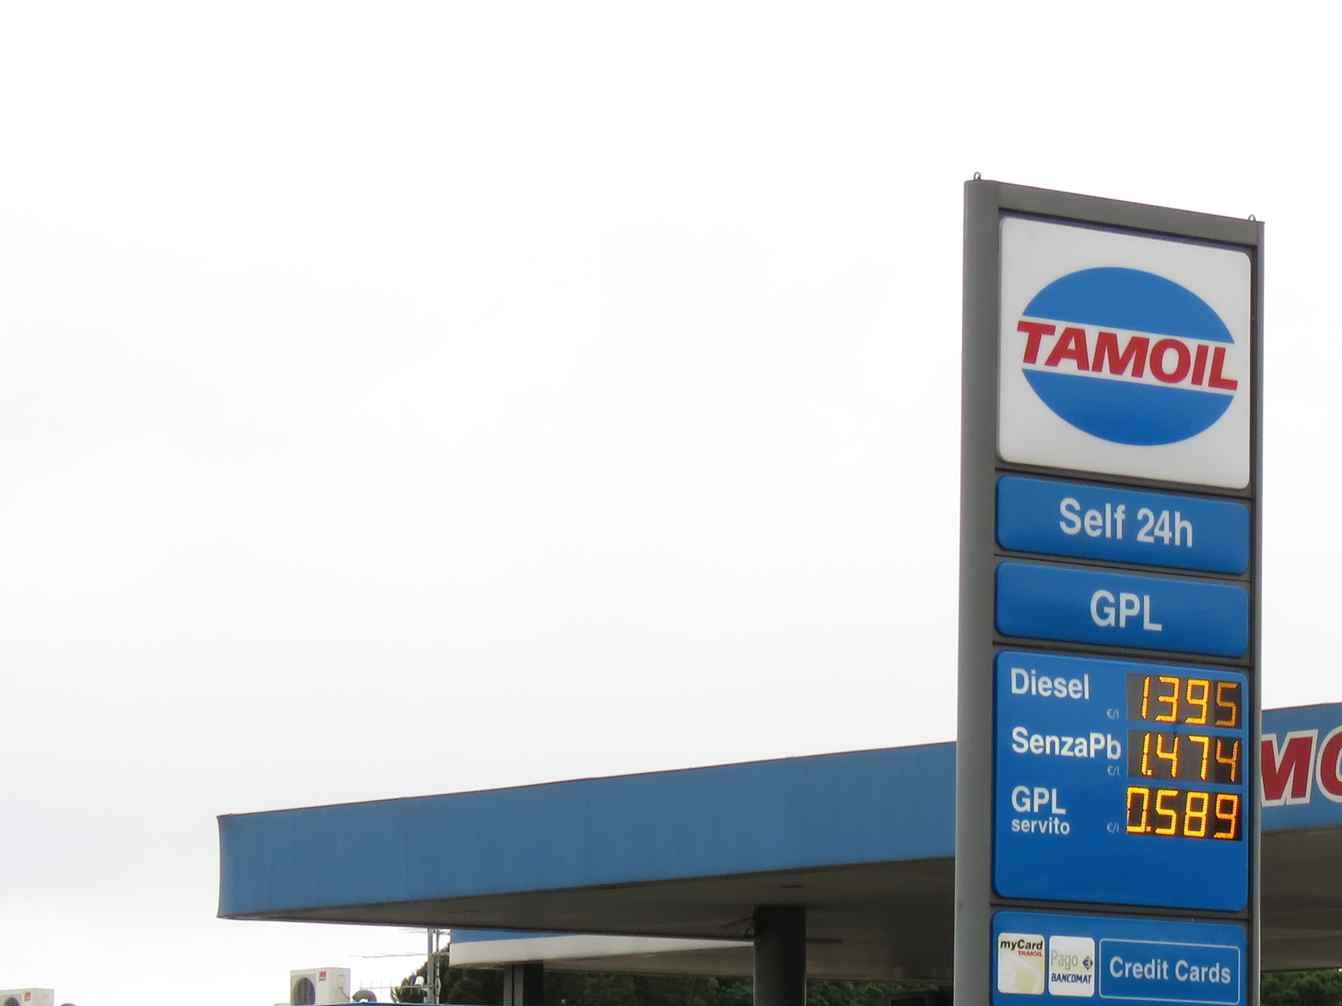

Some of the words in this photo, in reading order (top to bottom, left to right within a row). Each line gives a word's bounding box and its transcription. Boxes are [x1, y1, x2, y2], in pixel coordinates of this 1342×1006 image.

[1017, 320, 1238, 391] TAMOIL
[1059, 498, 1126, 539] Self
[1136, 507, 1192, 547] 24h
[1090, 589, 1162, 632] GPL
[1010, 667, 1090, 700] Diesel
[1011, 726, 1121, 760] SenzaPb
[1011, 785, 1067, 815] GPL
[1011, 816, 1070, 836] servito
[1000, 939, 1043, 951] myCard
[1051, 973, 1092, 984] BANCOMAT
[1109, 956, 1169, 981] Credit
[1175, 959, 1232, 984] Cards
